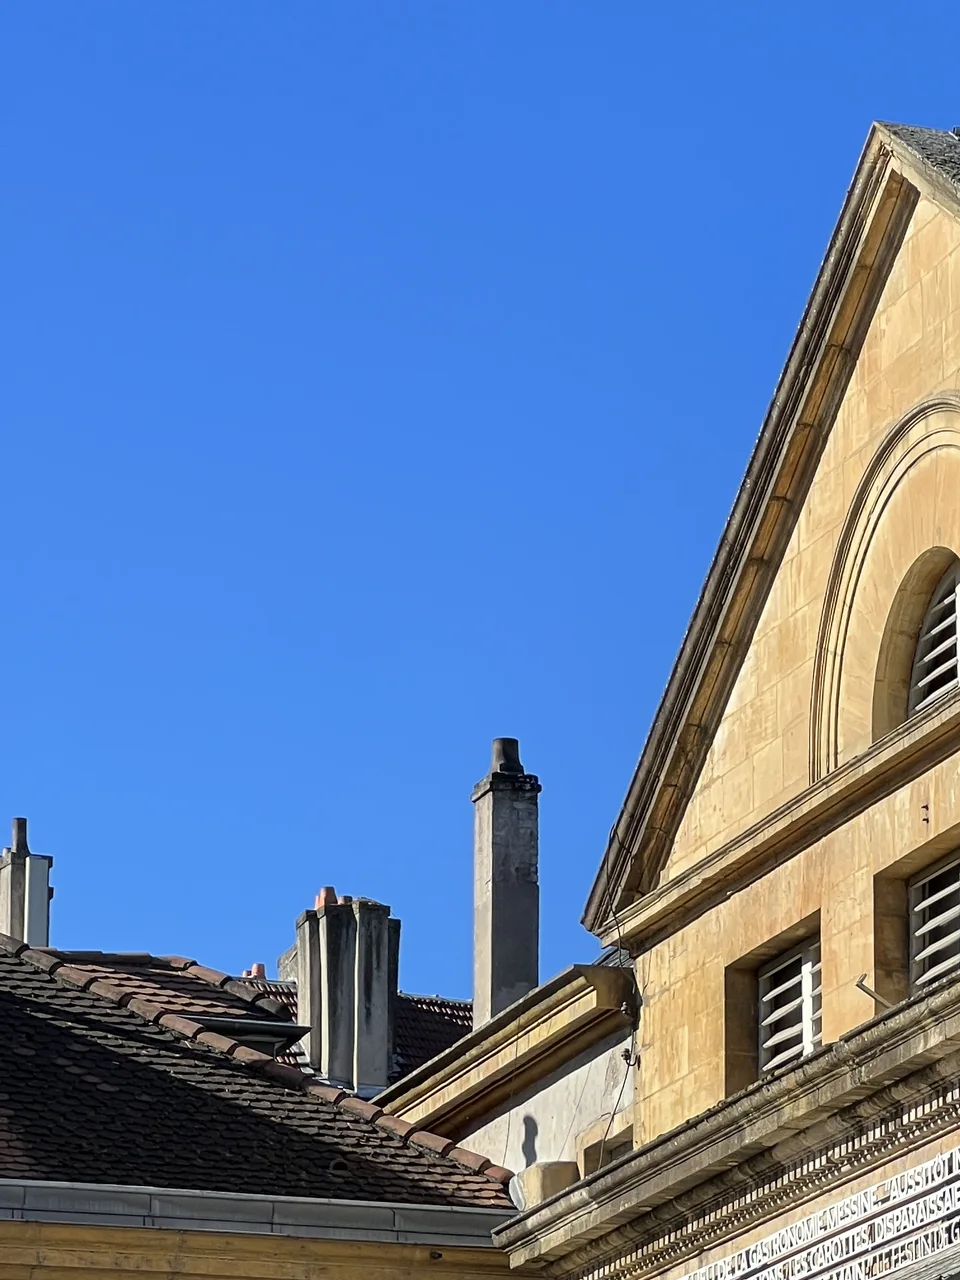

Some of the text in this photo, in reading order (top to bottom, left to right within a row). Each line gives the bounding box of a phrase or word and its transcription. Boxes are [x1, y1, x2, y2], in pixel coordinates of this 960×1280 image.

[718, 1255, 732, 1280] DE
[735, 1248, 746, 1273] LA
[749, 1211, 824, 1266] GASTRONOMIE
[789, 1252, 807, 1280] LES
